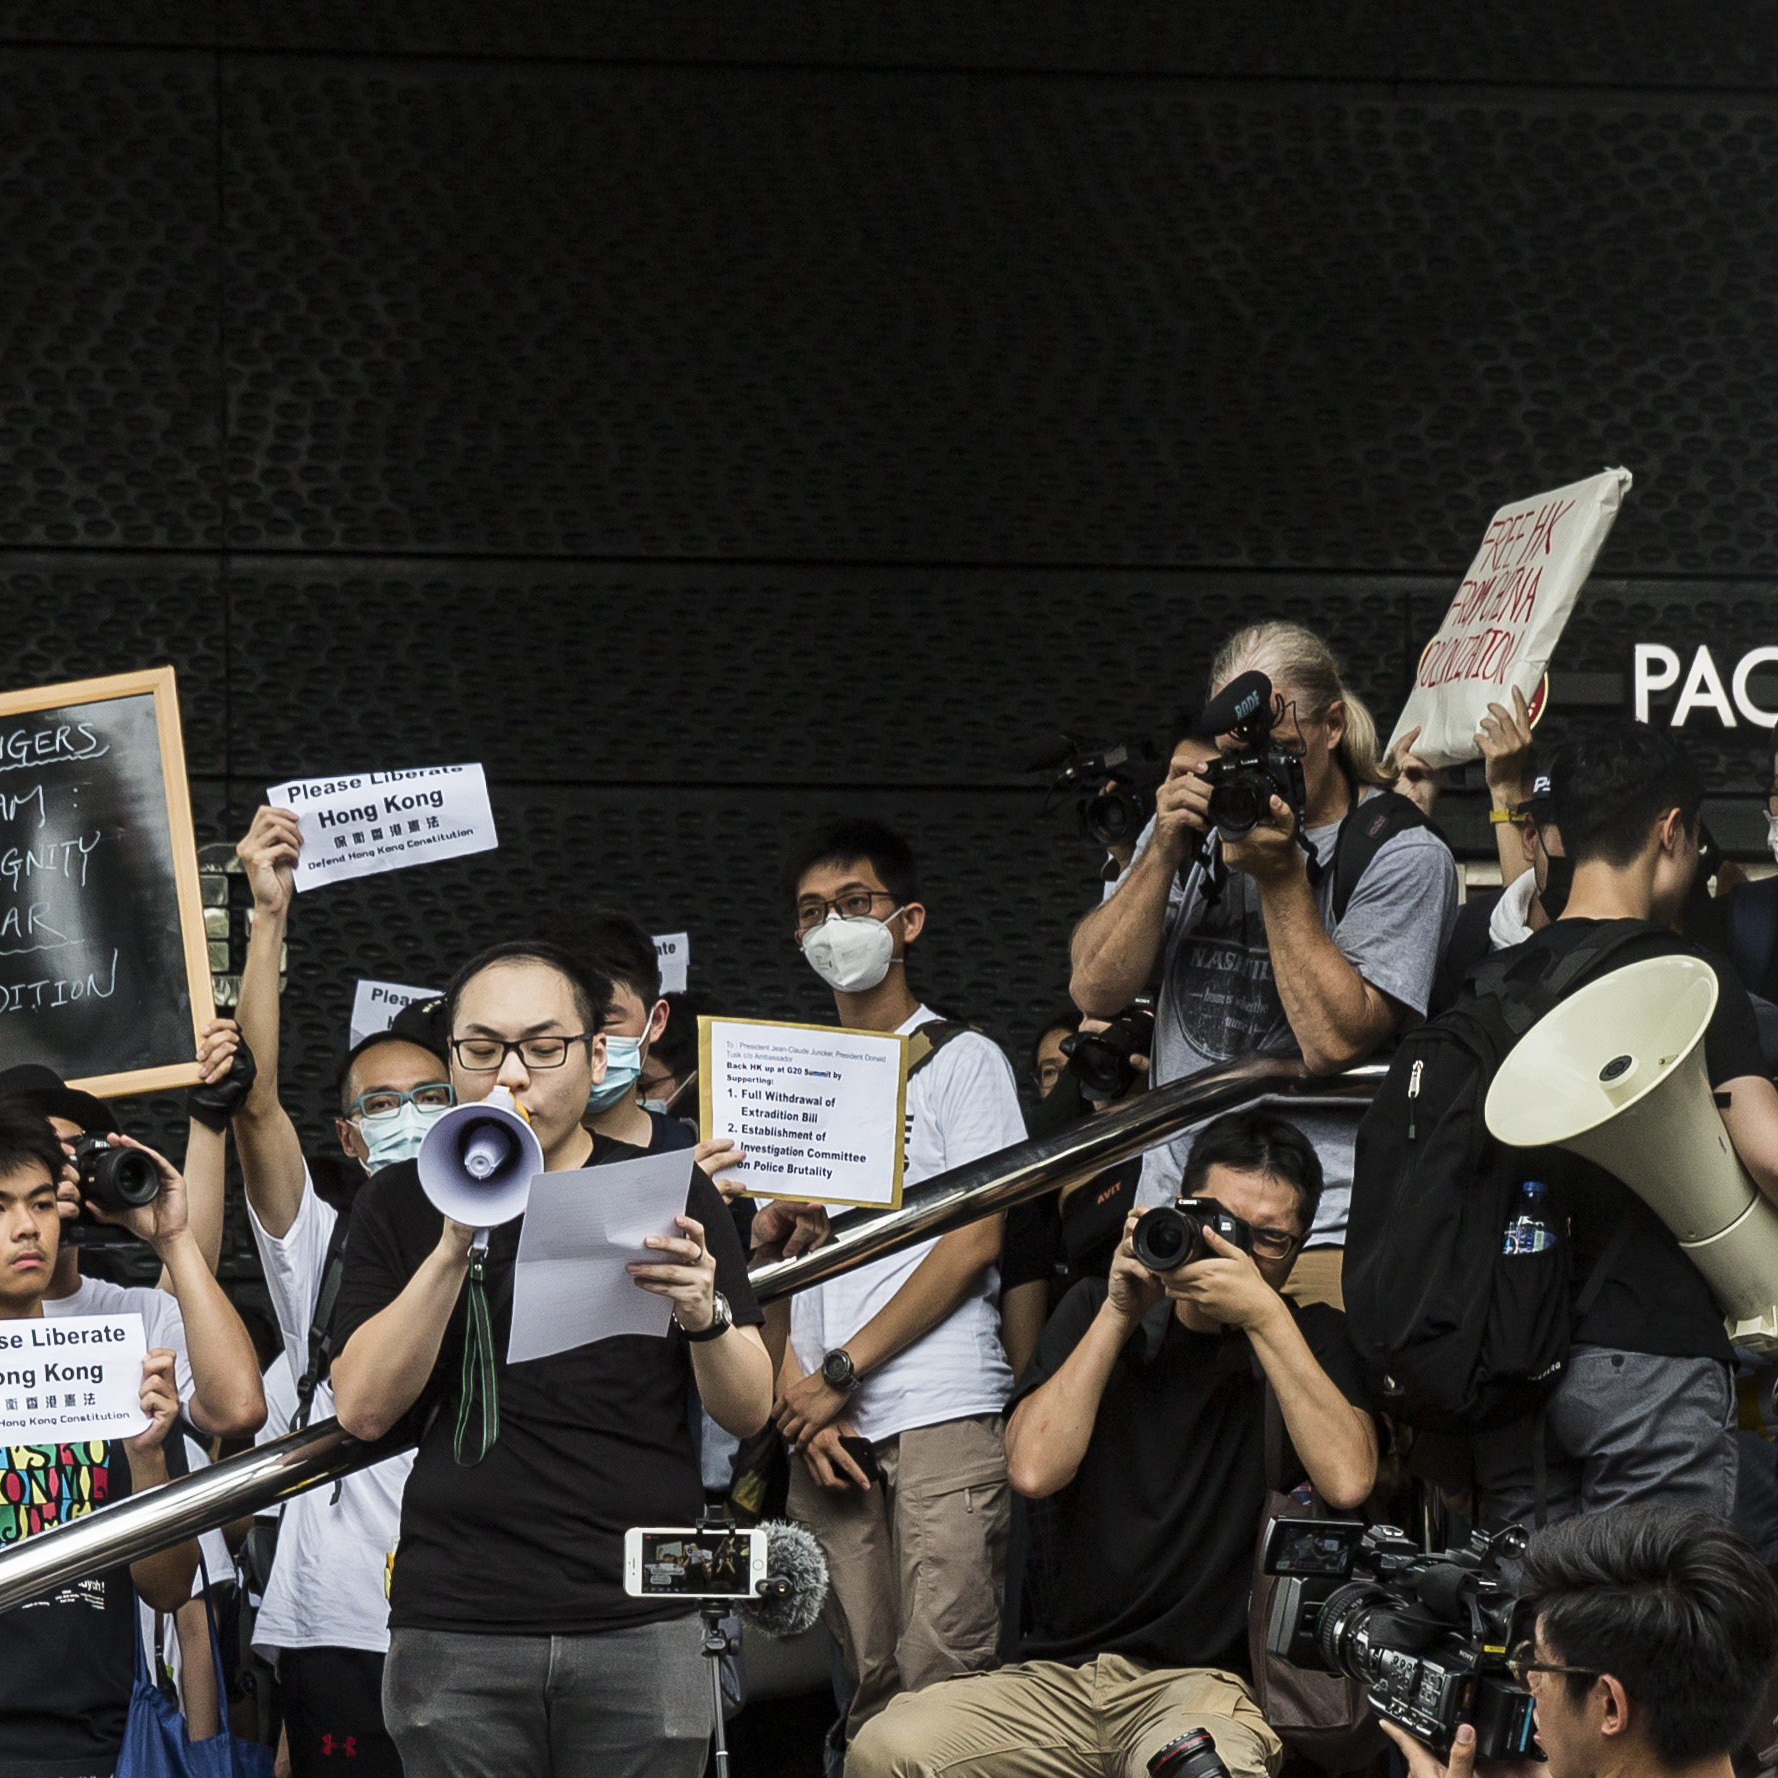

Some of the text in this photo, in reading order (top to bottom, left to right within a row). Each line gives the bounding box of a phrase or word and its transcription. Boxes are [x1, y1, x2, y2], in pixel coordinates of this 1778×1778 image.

[286, 778, 362, 804] Please
[318, 789, 444, 829] Hong Kong
[307, 826, 474, 871] Defend Hong Kong Constitution
[726, 1050, 742, 1060] Tusk
[739, 1041, 771, 1052] President
[771, 1043, 809, 1056] Jean-Claude
[835, 1050, 864, 1062] President
[864, 1053, 887, 1063] Donald
[726, 1062, 747, 1071] Back
[750, 1063, 762, 1072] HK
[764, 1065, 775, 1074] up
[777, 1065, 785, 1074] at
[787, 1066, 803, 1076] G20
[833, 1071, 843, 1081] by
[726, 1074, 775, 1086] Supporting:
[727, 1087, 837, 1108] 1. Full Withdrawal of
[741, 1106, 818, 1124] Extradition Bill
[727, 1122, 827, 1142] 2. Establishment of
[740, 1141, 867, 1164] Investigation Committee
[737, 1160, 834, 1179] on Police Brutality
[31, 1324, 126, 1348] Liberate
[44, 1362, 104, 1385] Kong
[29, 1415, 58, 1427] Kong
[59, 1410, 131, 1424] Constitution
